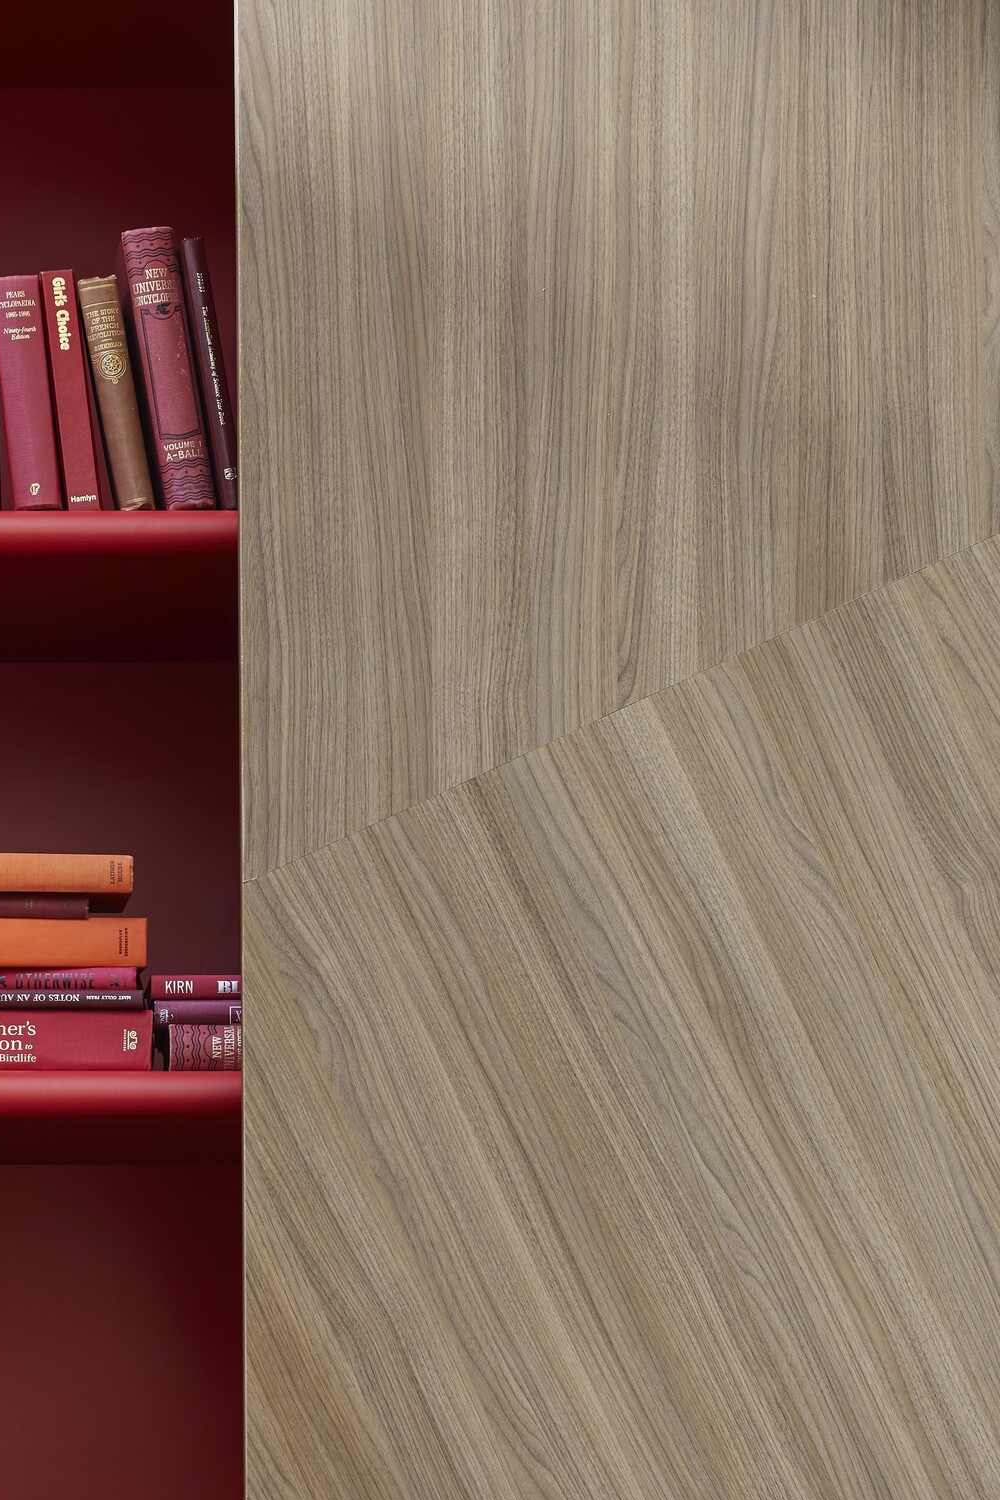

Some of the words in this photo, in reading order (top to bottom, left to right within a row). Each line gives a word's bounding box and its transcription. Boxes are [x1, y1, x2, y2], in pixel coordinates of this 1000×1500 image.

[145, 268, 168, 280] NEW
[5, 290, 25, 298] PEARS
[86, 310, 99, 319] THE
[91, 317, 100, 325] OF
[102, 315, 116, 323] THE
[3, 326, 36, 334] Ninety-fourth
[56, 310, 72, 350] Choice
[91, 322, 119, 333] FRENCH
[166, 451, 204, 462] A-BALL
[70, 494, 97, 503] Hamlyn
[15, 973, 96, 990] OTHERWISE
[165, 980, 193, 994] KIRN
[17, 993, 30, 1001] AN
[33, 993, 45, 1001] OF
[48, 993, 81, 1001] NOTES
[212, 1036, 222, 1059] NEW
